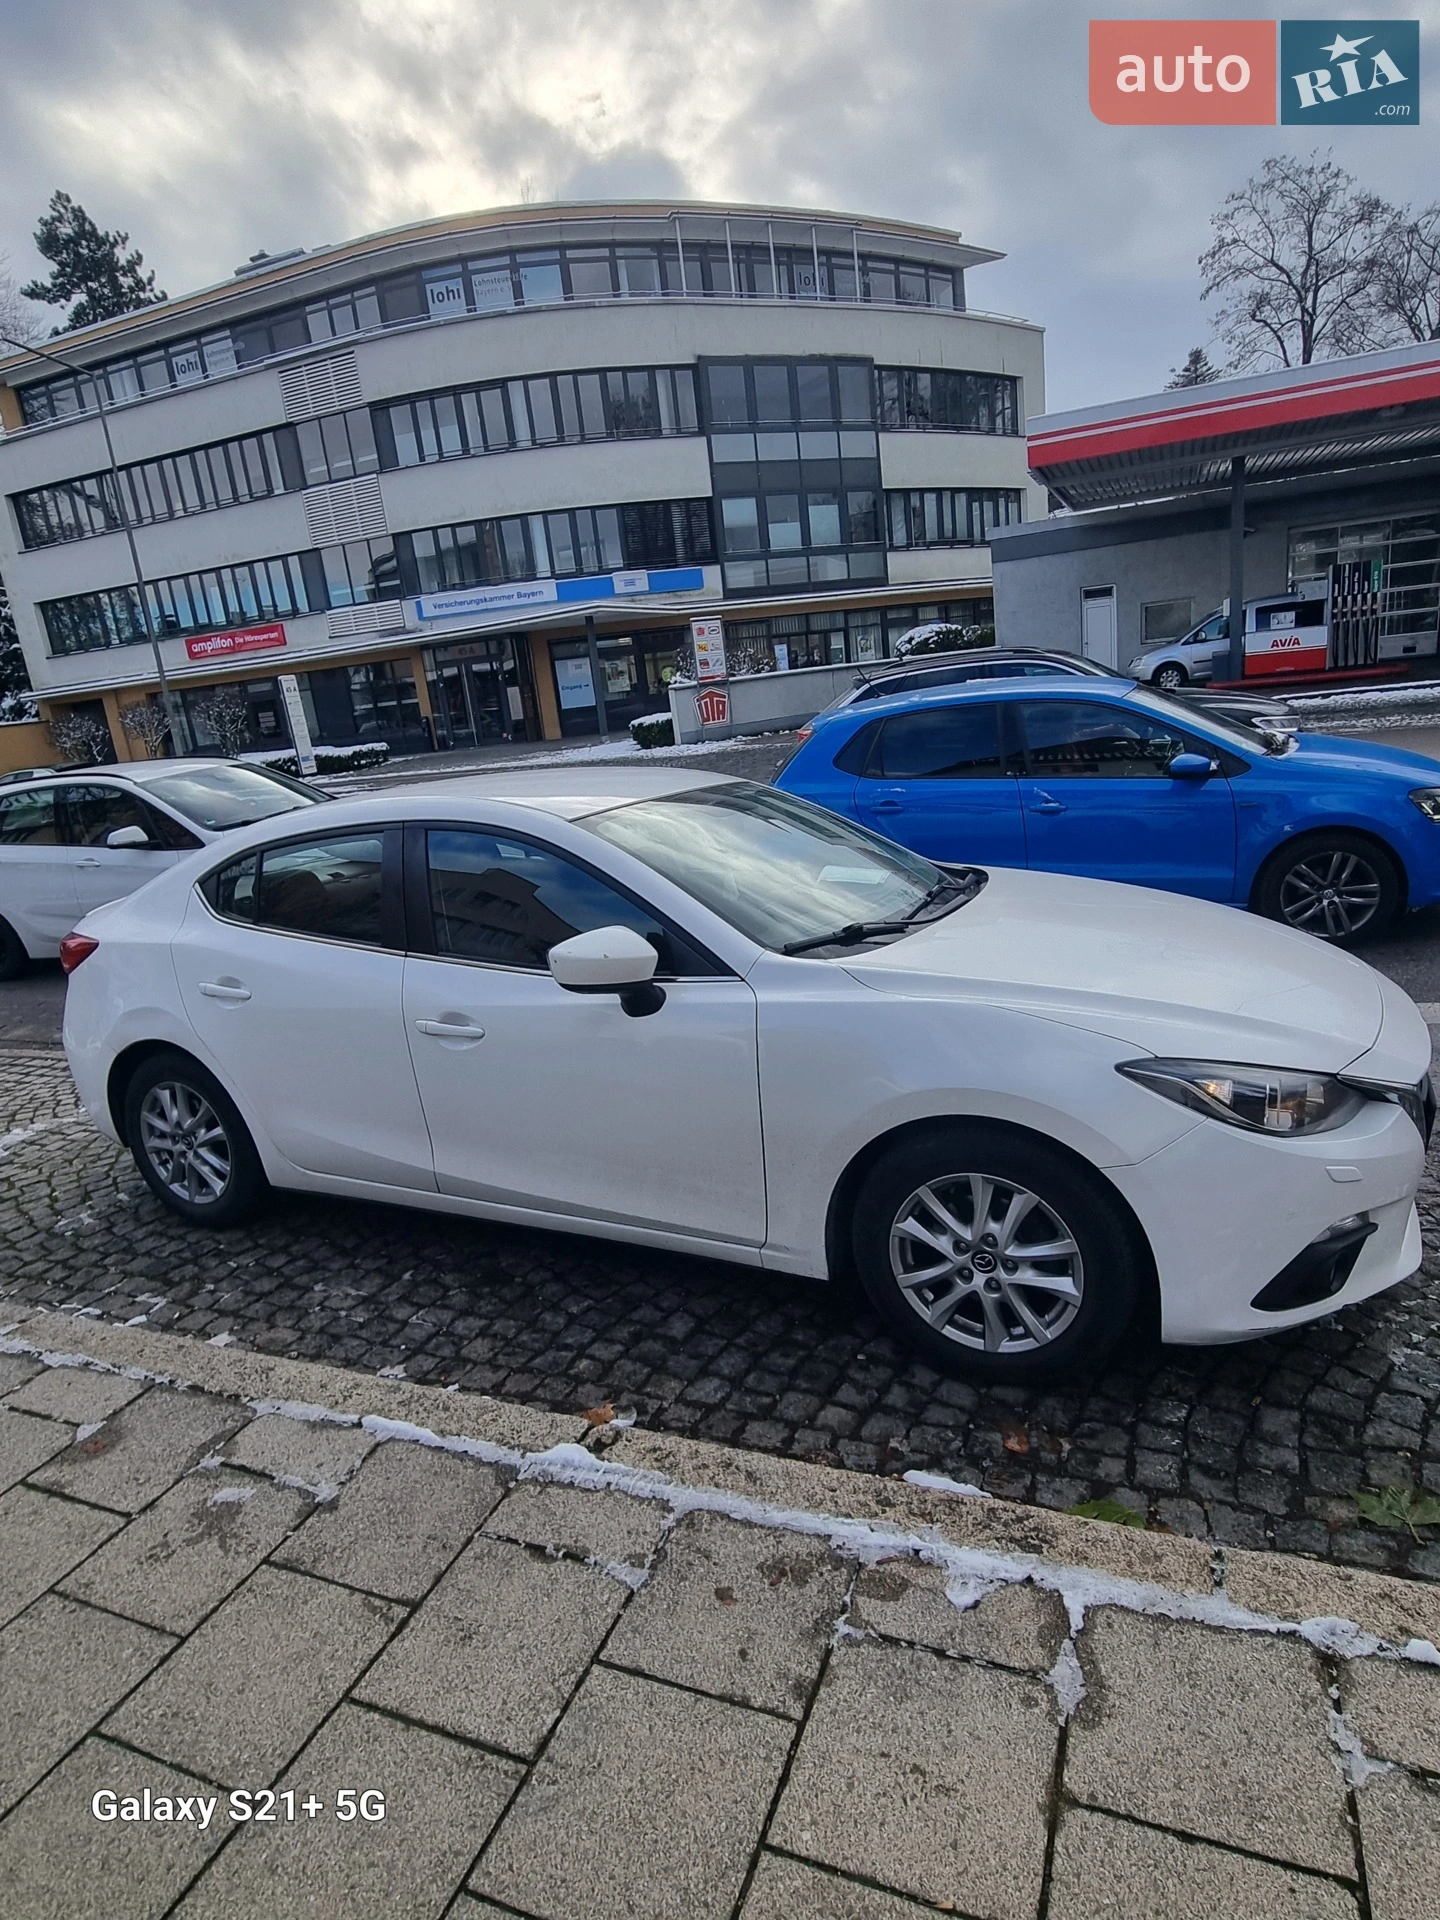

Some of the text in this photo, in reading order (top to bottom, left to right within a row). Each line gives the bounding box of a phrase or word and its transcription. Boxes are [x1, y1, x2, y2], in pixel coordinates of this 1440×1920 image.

[430, 282, 461, 304] lohi
[175, 355, 200, 376] lohi
[432, 590, 544, 610] Versicherungskammer Bayern
[192, 638, 233, 653] amplifon
